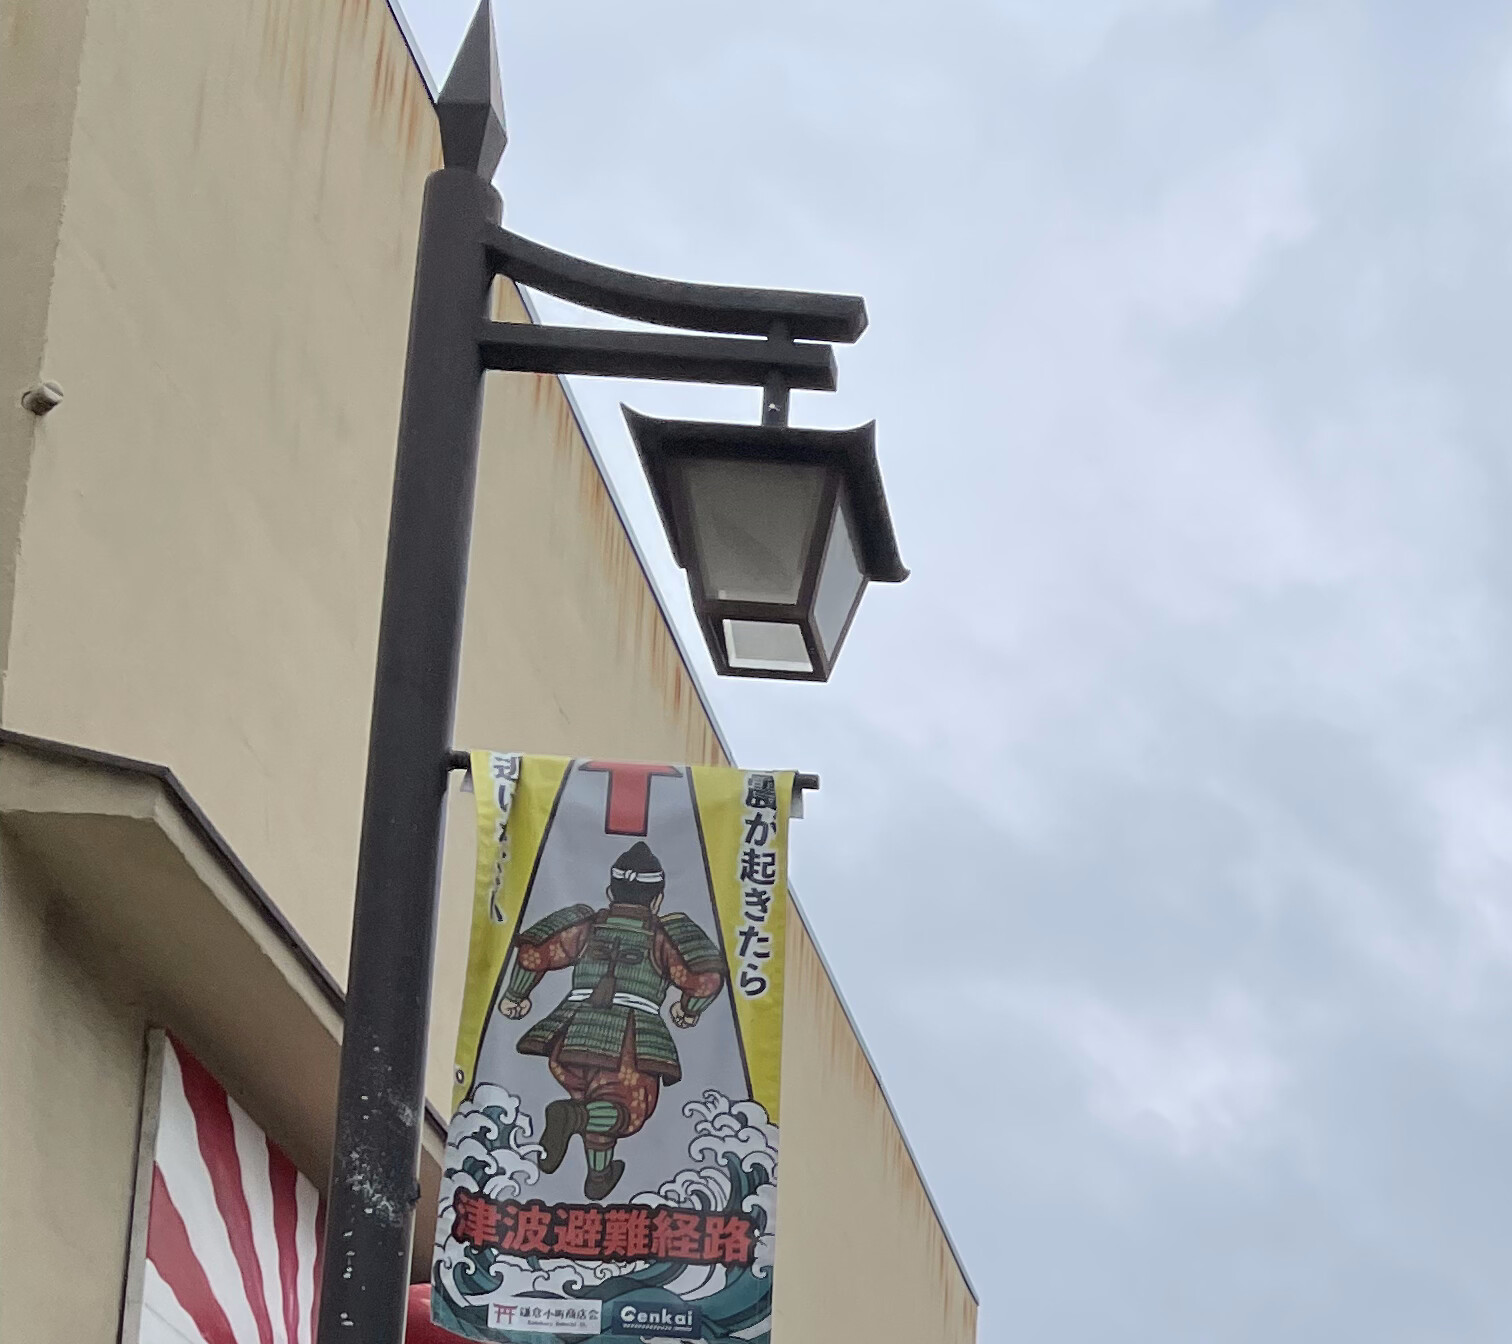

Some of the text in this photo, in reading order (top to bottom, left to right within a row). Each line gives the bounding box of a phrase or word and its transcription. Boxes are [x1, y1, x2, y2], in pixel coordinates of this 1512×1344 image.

[457, 1192, 752, 1264] 津波避難経路
